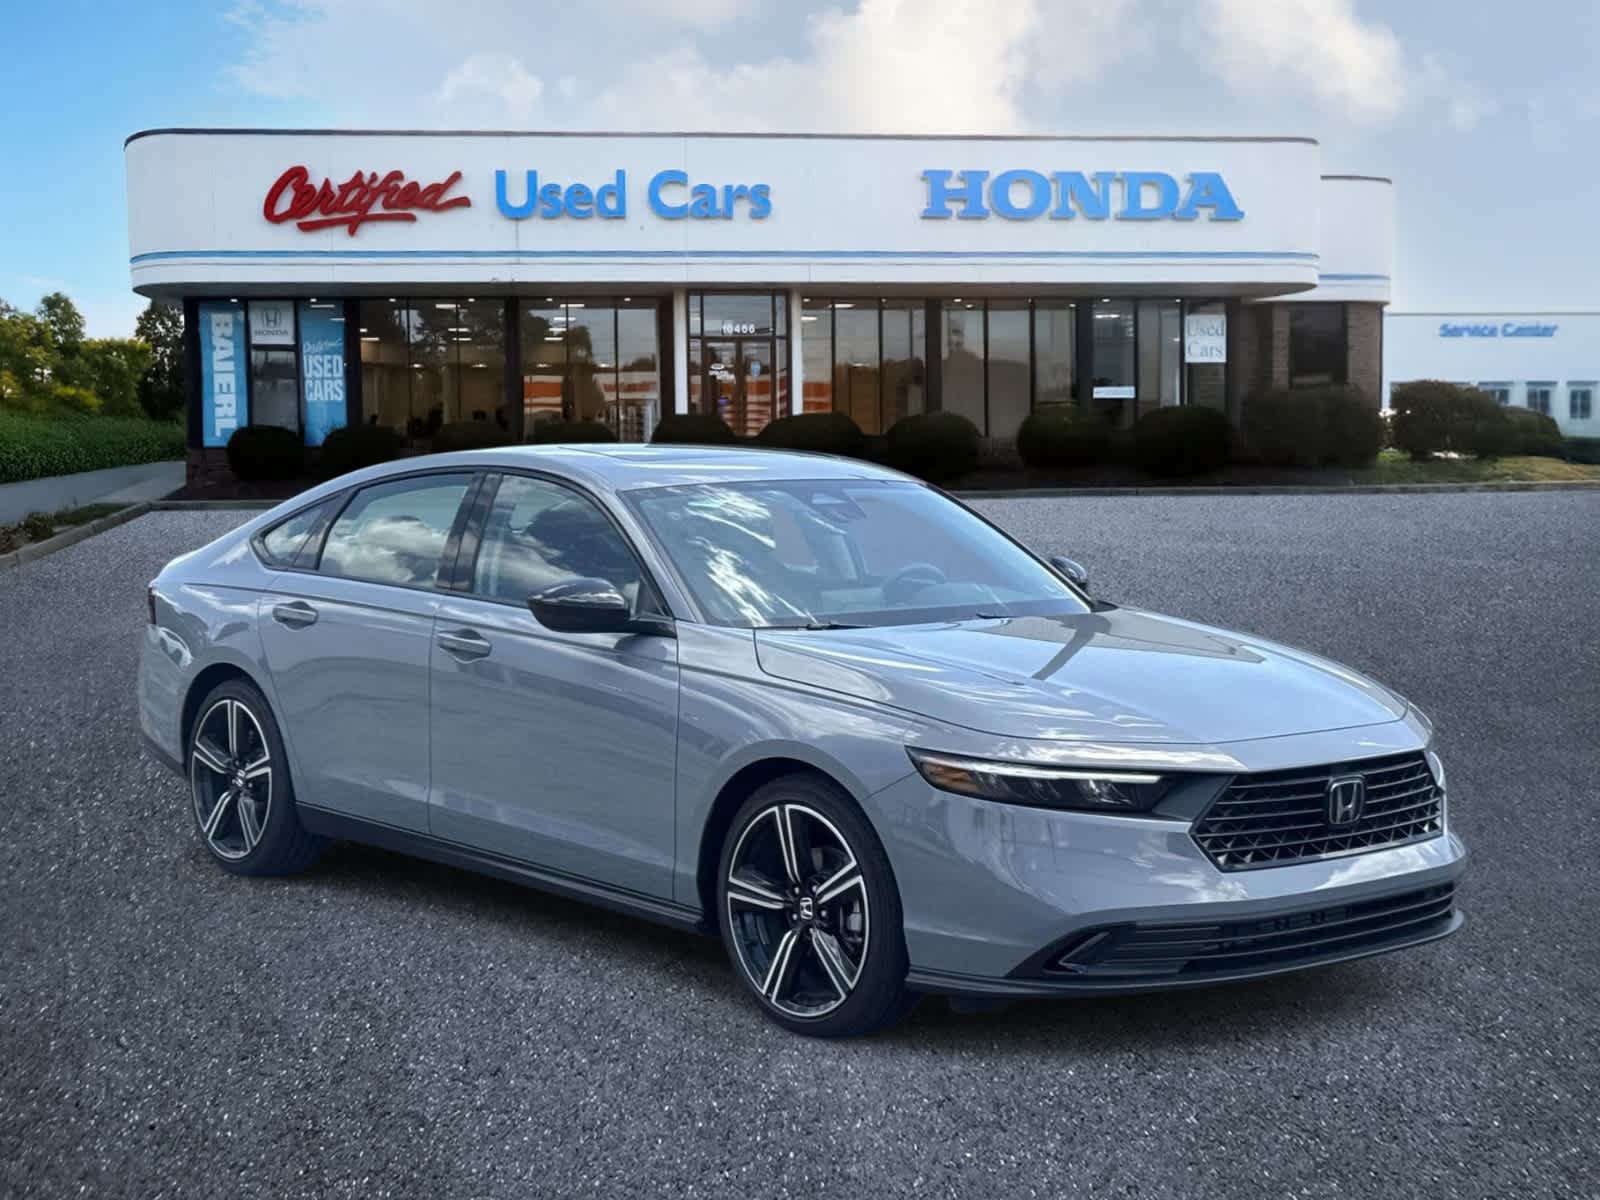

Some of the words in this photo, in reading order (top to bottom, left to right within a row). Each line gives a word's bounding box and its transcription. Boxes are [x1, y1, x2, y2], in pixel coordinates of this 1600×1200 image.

[262, 165, 472, 238] Certified
[495, 168, 627, 220] Used
[648, 168, 773, 220] Cars
[920, 169, 1246, 222] HONDA
[254, 328, 289, 336] HONDA
[1187, 318, 1226, 337] Used
[1439, 323, 1499, 338] Service
[1501, 323, 1559, 338] Center
[1187, 343, 1225, 358] Cars
[210, 312, 238, 438] BAIERL
[303, 354, 344, 378] USED
[304, 379, 345, 401] CARS
